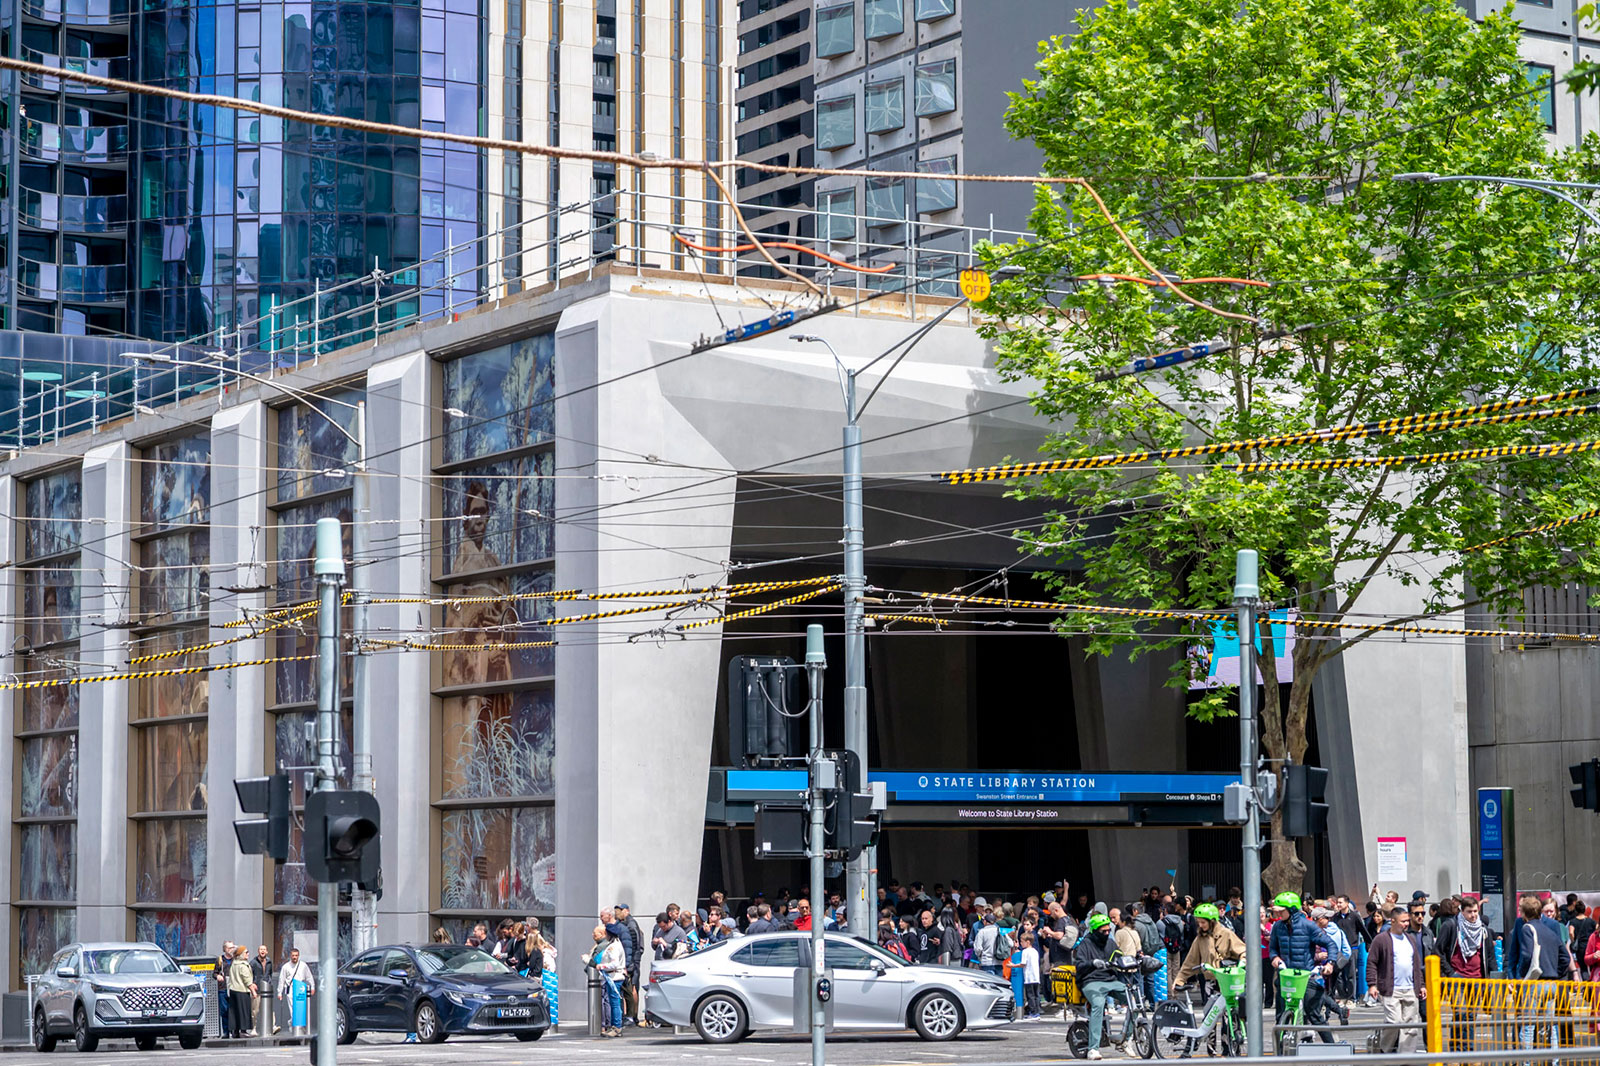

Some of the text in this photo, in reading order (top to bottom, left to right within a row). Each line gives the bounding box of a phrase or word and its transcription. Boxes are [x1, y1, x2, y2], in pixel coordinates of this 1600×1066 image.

[964, 271, 984, 282] CUT
[966, 284, 986, 296] OFF
[934, 777, 1096, 788] STATE LIBRARY STATION
[958, 809, 987, 818] Welcome
[996, 810, 1012, 818] State
[1014, 810, 1035, 819] Library
[1036, 810, 1058, 818] Station
